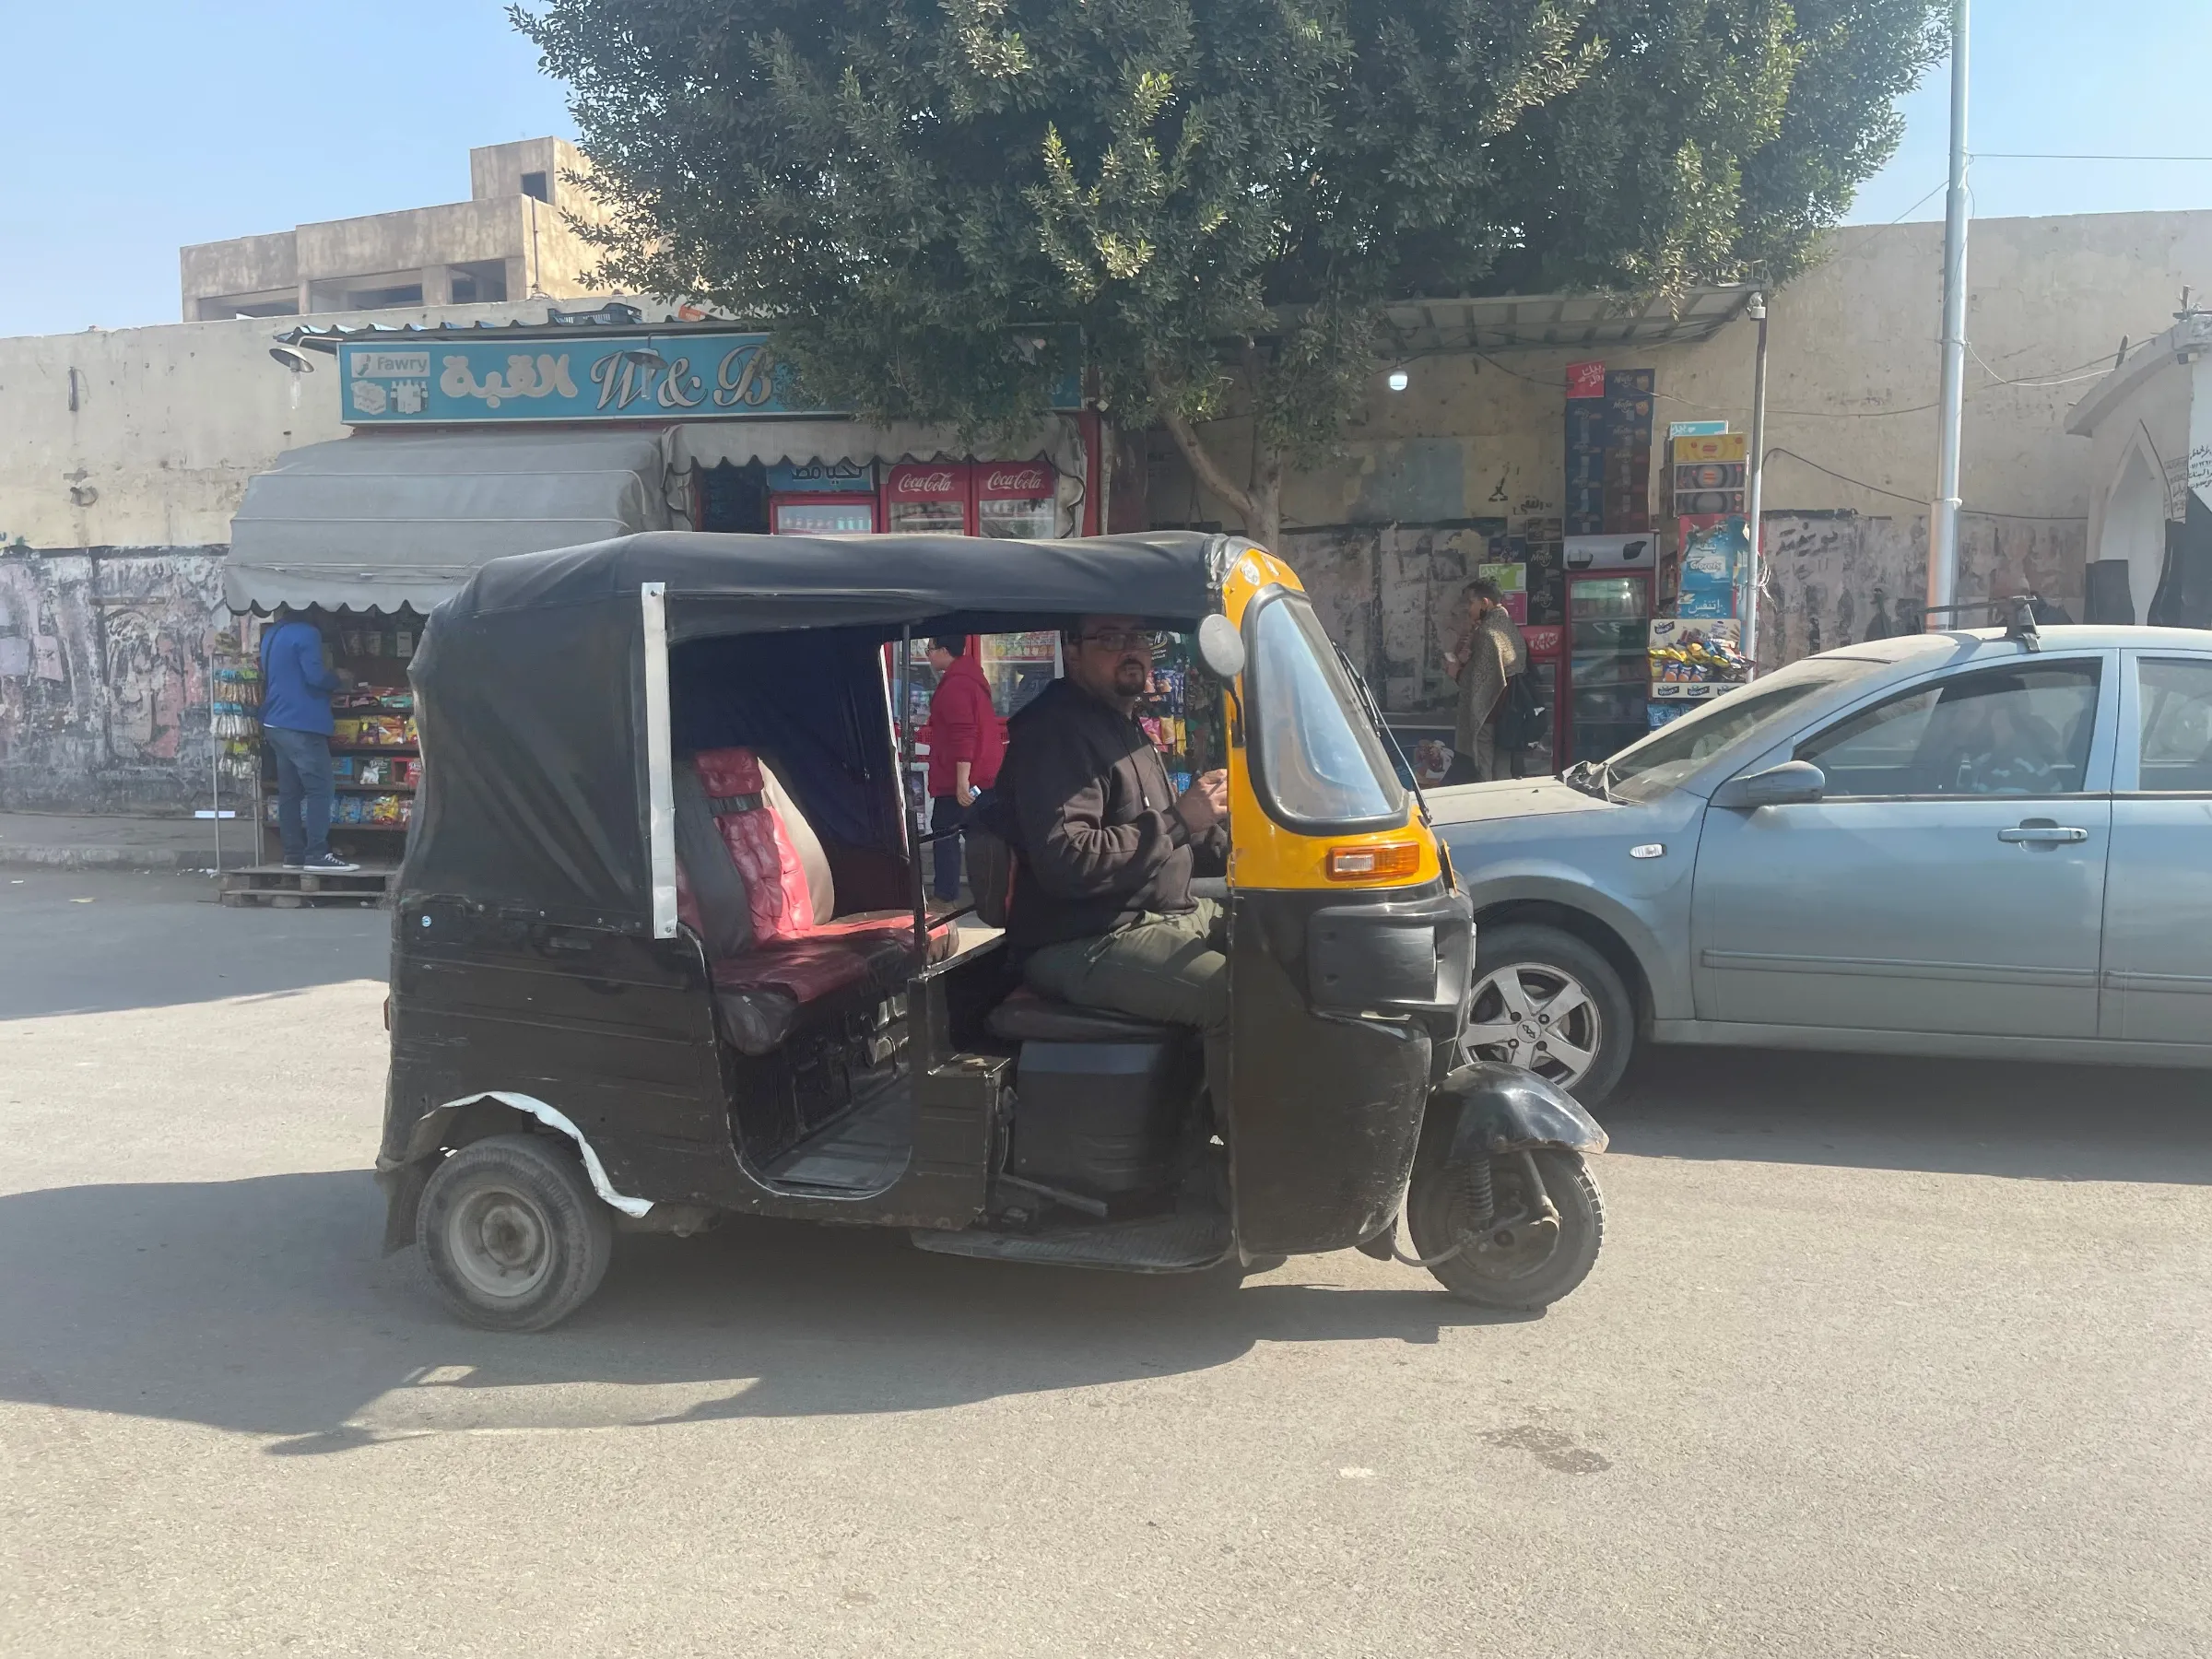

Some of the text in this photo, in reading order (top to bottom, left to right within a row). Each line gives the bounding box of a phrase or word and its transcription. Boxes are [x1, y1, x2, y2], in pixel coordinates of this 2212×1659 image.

[377, 356, 428, 372] Fawry
[440, 354, 578, 408] القبة
[590, 344, 773, 409] W & B
[898, 472, 955, 492] Coca-Cola
[987, 469, 1044, 490] Coca-Cola
